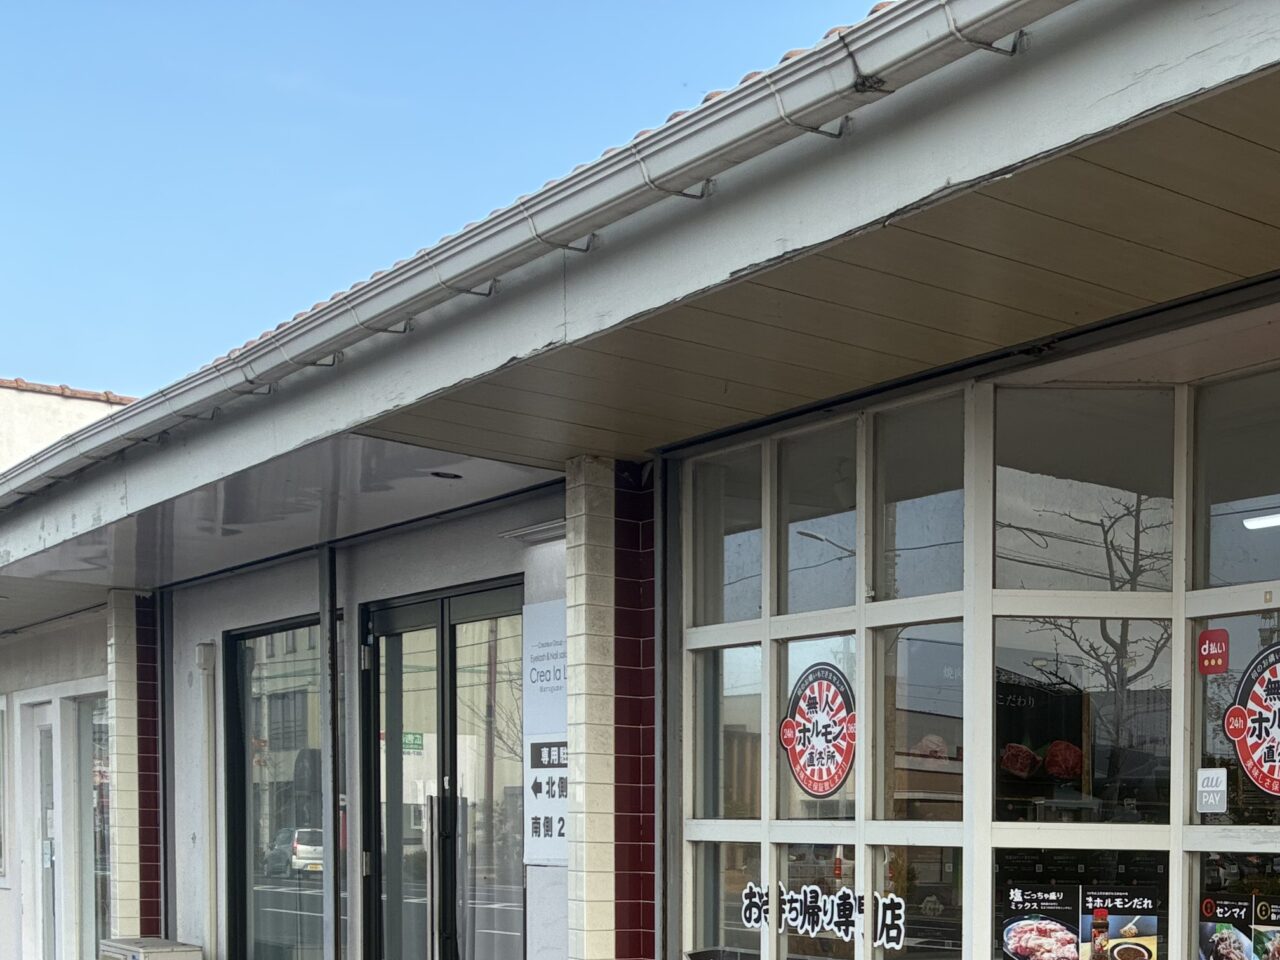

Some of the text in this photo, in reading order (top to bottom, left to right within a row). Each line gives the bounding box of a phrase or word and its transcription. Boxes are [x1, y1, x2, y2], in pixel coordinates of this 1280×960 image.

[530, 667, 551, 684] Crea
[806, 693, 834, 715] 無人
[1229, 716, 1244, 730] 24h
[798, 719, 845, 748] ホルモン
[806, 750, 837, 767] 直売所
[1202, 793, 1220, 806] PAY
[531, 816, 553, 838] 南側
[1010, 901, 1039, 910] ミックス
[1216, 906, 1248, 920] センマイ
